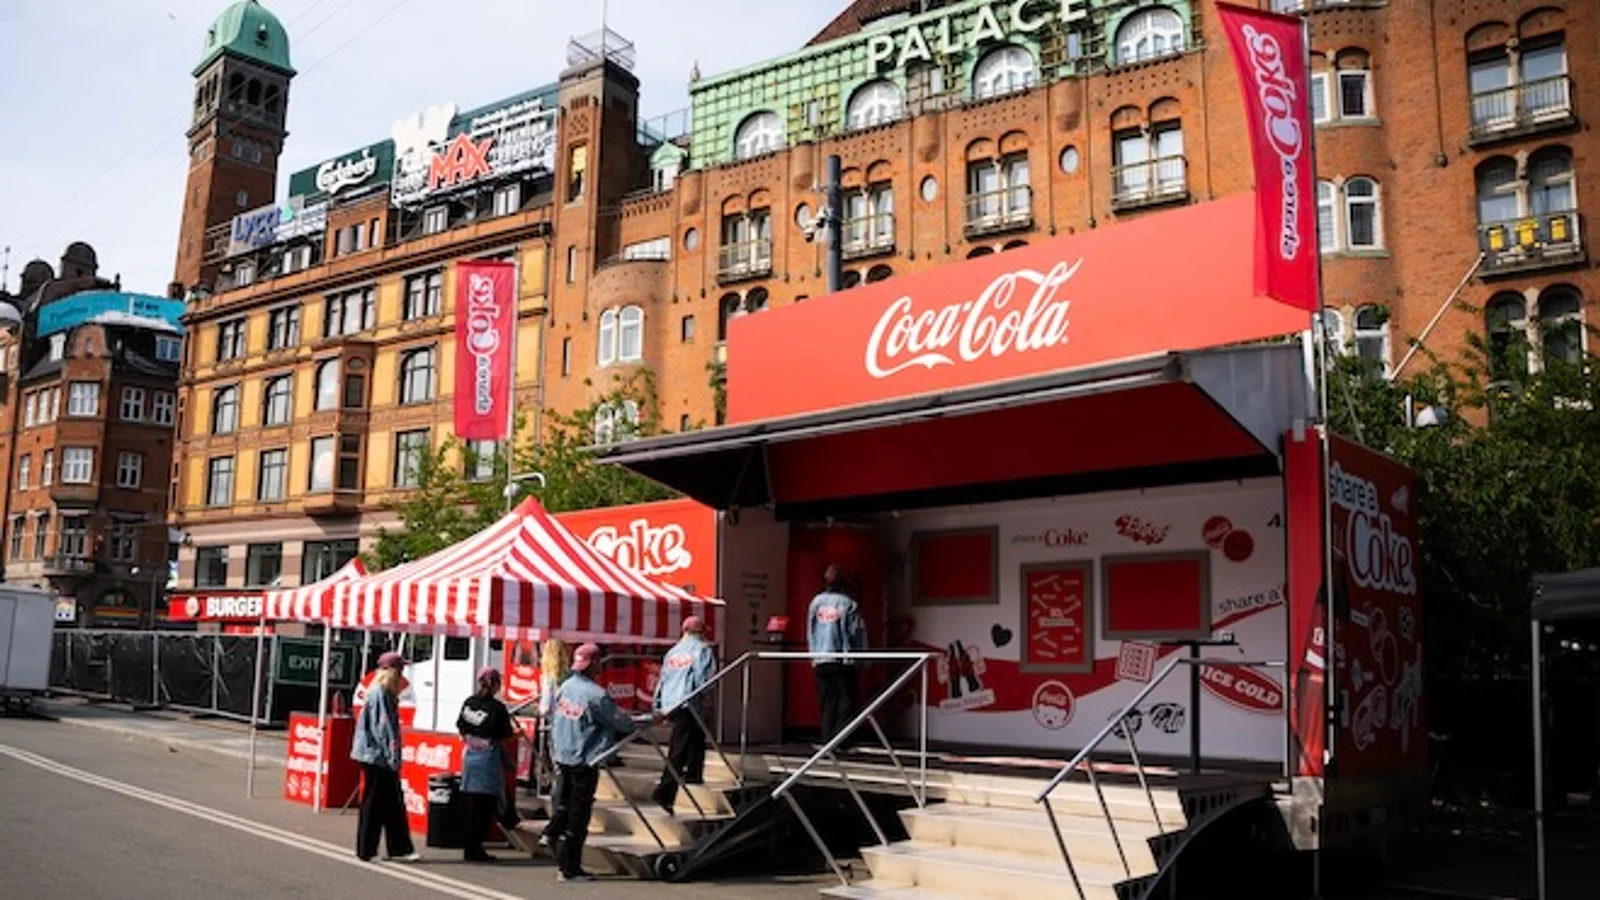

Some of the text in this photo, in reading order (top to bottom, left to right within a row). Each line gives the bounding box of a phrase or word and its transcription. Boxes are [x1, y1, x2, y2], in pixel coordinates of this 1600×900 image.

[867, 0, 1087, 74] PALACE
[429, 133, 494, 192] MAX
[866, 256, 1083, 378] Coca-Cola
[590, 521, 685, 573] Coke
[1045, 527, 1089, 546] Coke
[1350, 510, 1411, 590] Coke
[1219, 592, 1265, 612] share
[289, 655, 321, 670] EXIT
[1205, 665, 1279, 706] ICE COLD
